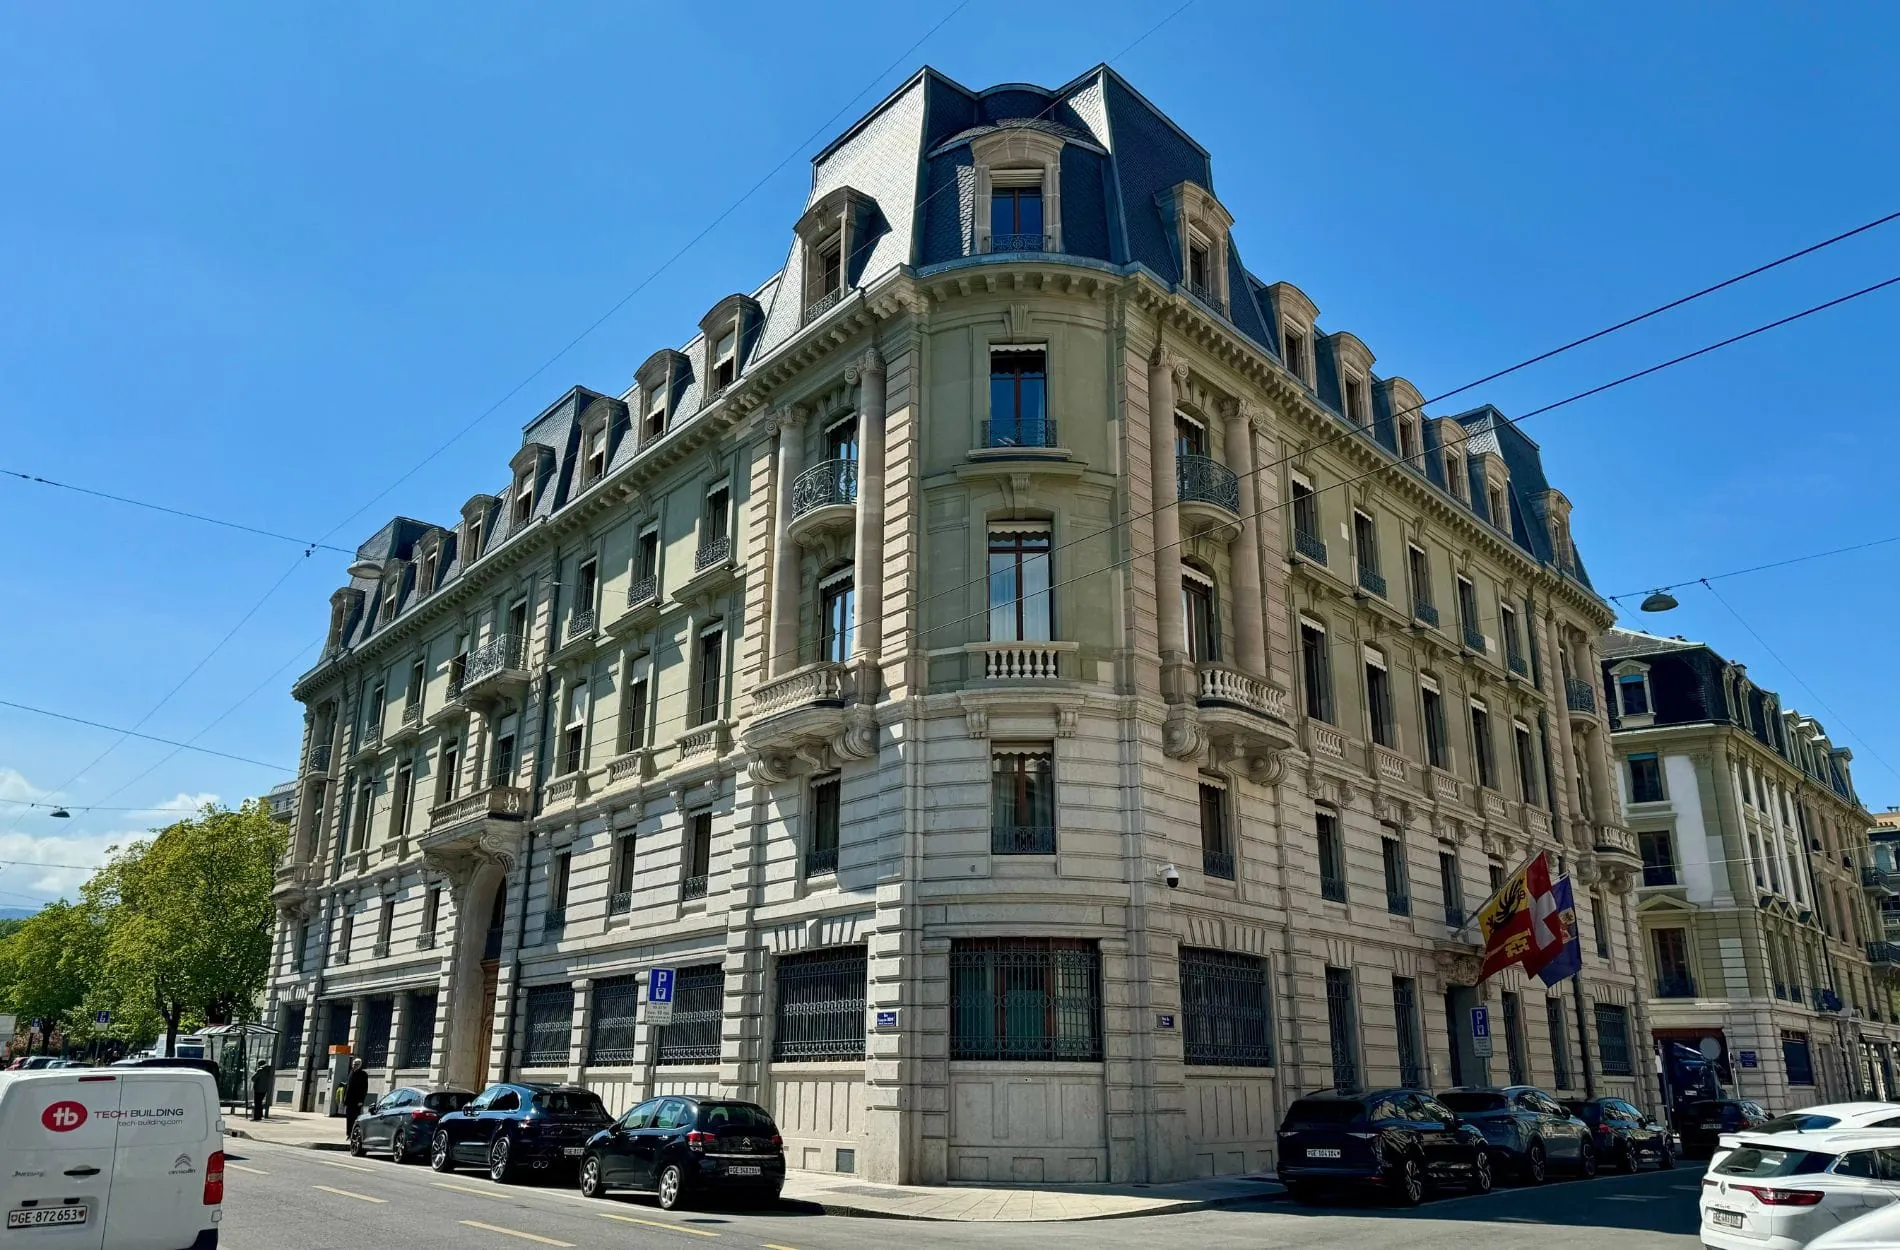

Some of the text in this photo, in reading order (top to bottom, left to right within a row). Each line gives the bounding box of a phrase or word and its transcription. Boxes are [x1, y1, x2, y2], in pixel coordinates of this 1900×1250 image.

[657, 971, 667, 987] P
[1476, 1010, 1483, 1025] P
[53, 1107, 79, 1126] tb
[94, 1108, 184, 1119] TECH BUILDING
